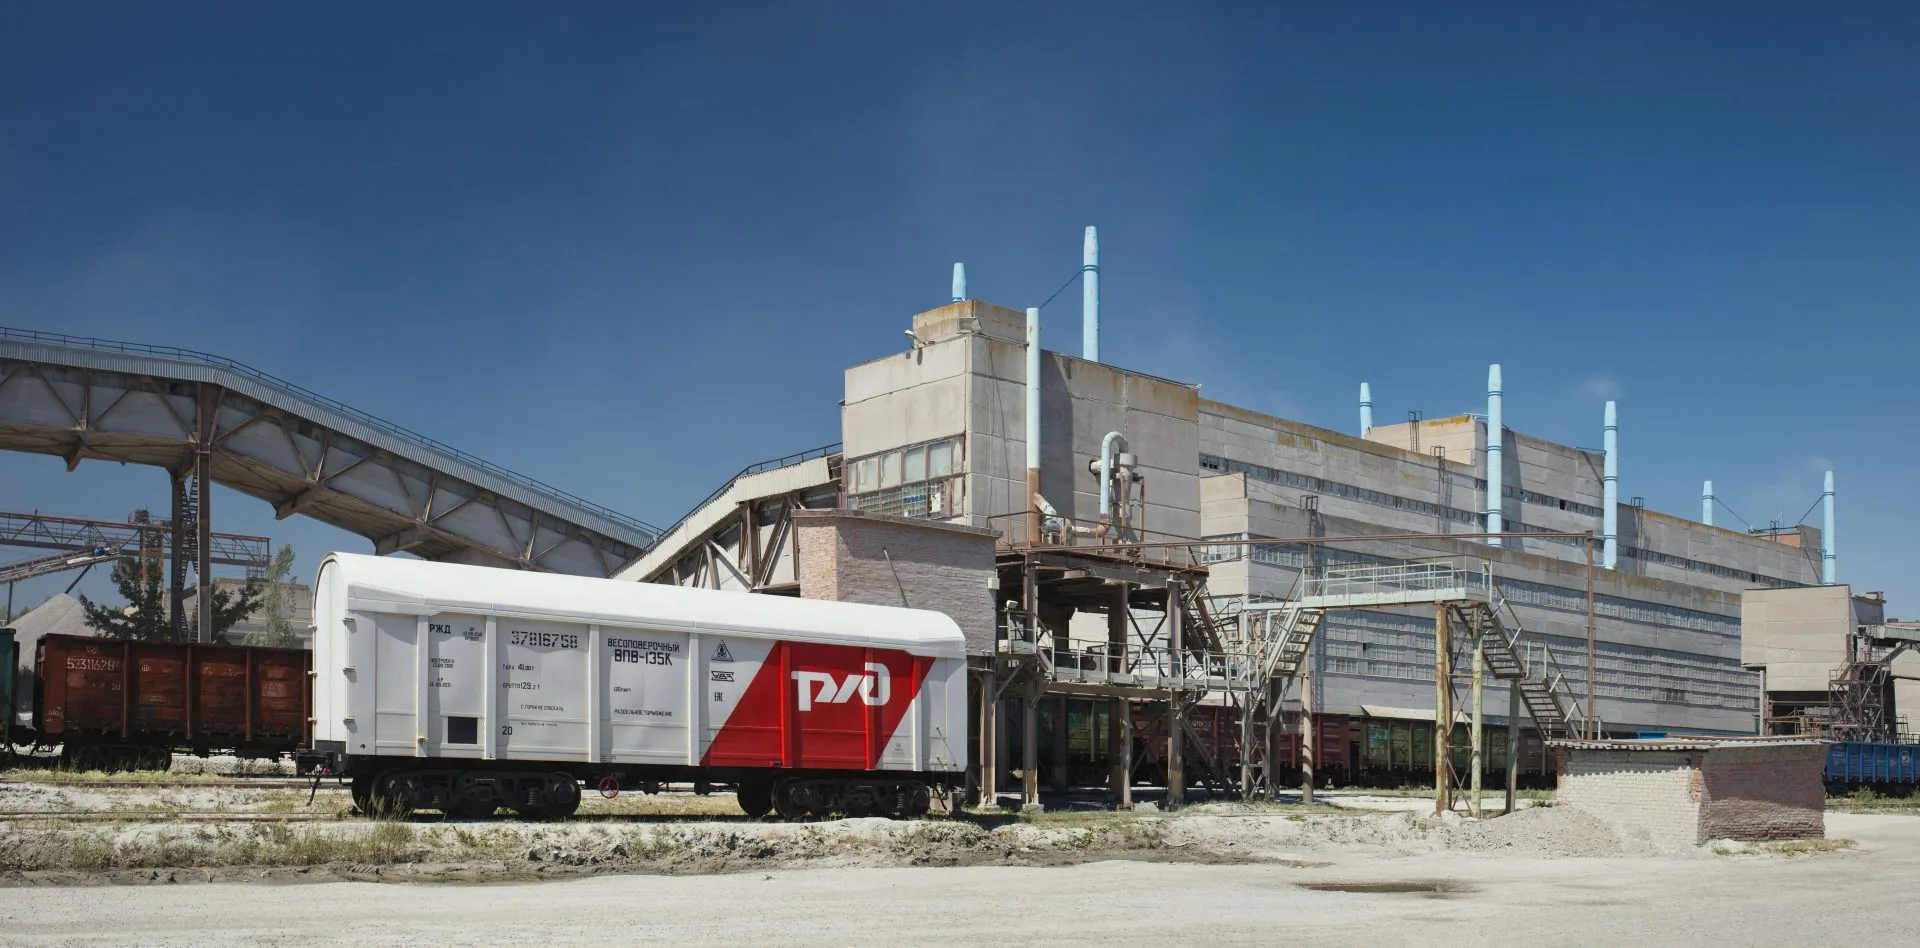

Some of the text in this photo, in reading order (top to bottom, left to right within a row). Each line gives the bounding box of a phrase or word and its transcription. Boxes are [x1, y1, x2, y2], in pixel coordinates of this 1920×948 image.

[429, 623, 451, 634] РЖД
[511, 630, 578, 648] 37816758
[607, 638, 680, 653] ВЕСОПОВЕРОЧНЫЙ
[66, 657, 115, 671] 52311628
[614, 649, 673, 666] ВПВ-135К
[501, 725, 513, 736] 20
